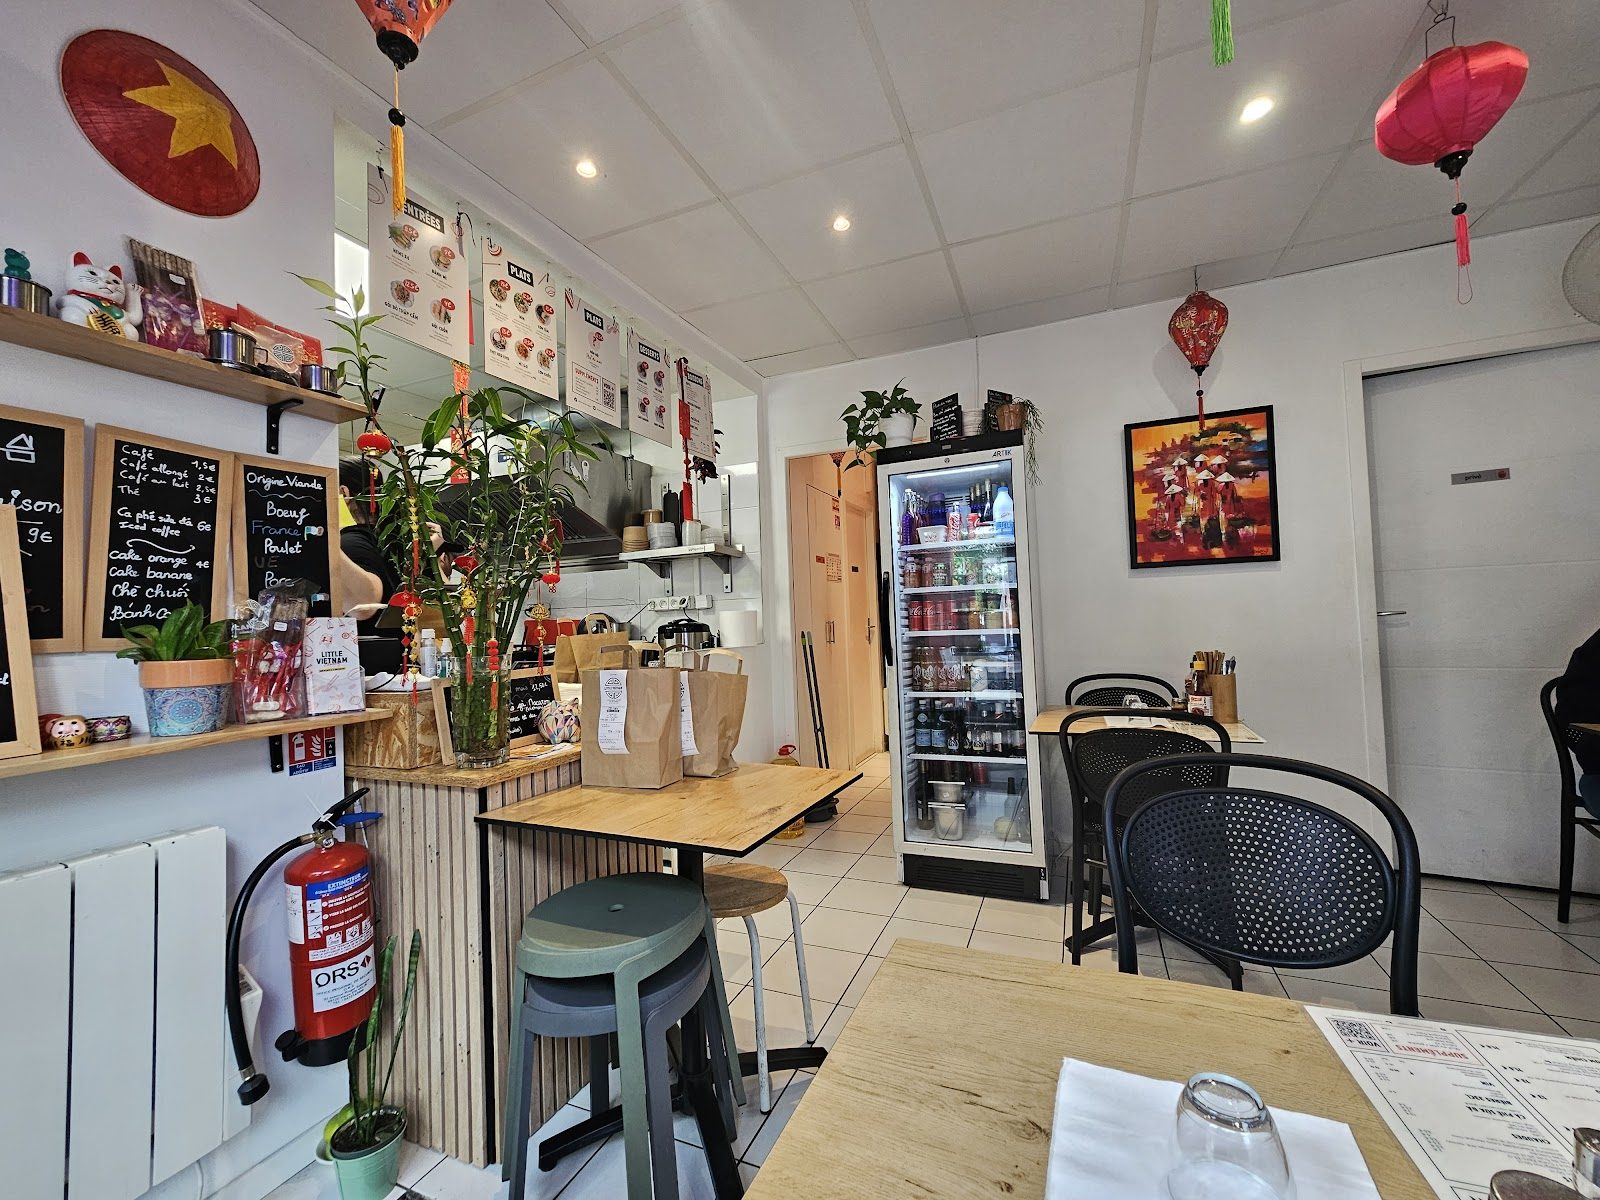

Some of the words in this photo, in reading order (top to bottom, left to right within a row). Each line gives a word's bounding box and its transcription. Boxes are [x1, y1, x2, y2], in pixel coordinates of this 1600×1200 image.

[510, 265, 531, 283] PLATS
[586, 311, 603, 328] PLATS
[122, 445, 154, 461] Café
[191, 460, 216, 472] 1,5€
[120, 458, 148, 471] Café
[151, 463, 189, 480] allongé
[198, 474, 215, 483] 2€
[119, 470, 149, 484] Café
[172, 478, 190, 489] lait
[196, 484, 216, 494] 2,5€
[246, 472, 287, 491] Origine
[286, 475, 323, 490] Viande
[117, 485, 140, 496] Thé
[119, 521, 147, 531] Iced
[152, 525, 180, 538] coffee
[197, 521, 212, 531] 6€
[252, 520, 301, 536] France
[28, 527, 52, 543] 9€
[264, 538, 302, 554] Poulet
[109, 549, 142, 560] Cake
[148, 555, 188, 568] orange
[196, 561, 210, 569] 4€
[109, 565, 140, 577] Cake
[146, 566, 193, 580] banane
[265, 571, 295, 588] Porc
[109, 602, 156, 620] Bánh
[316, 657, 348, 665] VIETNAM
[321, 650, 343, 658] LITTLE
[315, 962, 360, 988] ORS
[1358, 1040, 1382, 1048] VOIR
